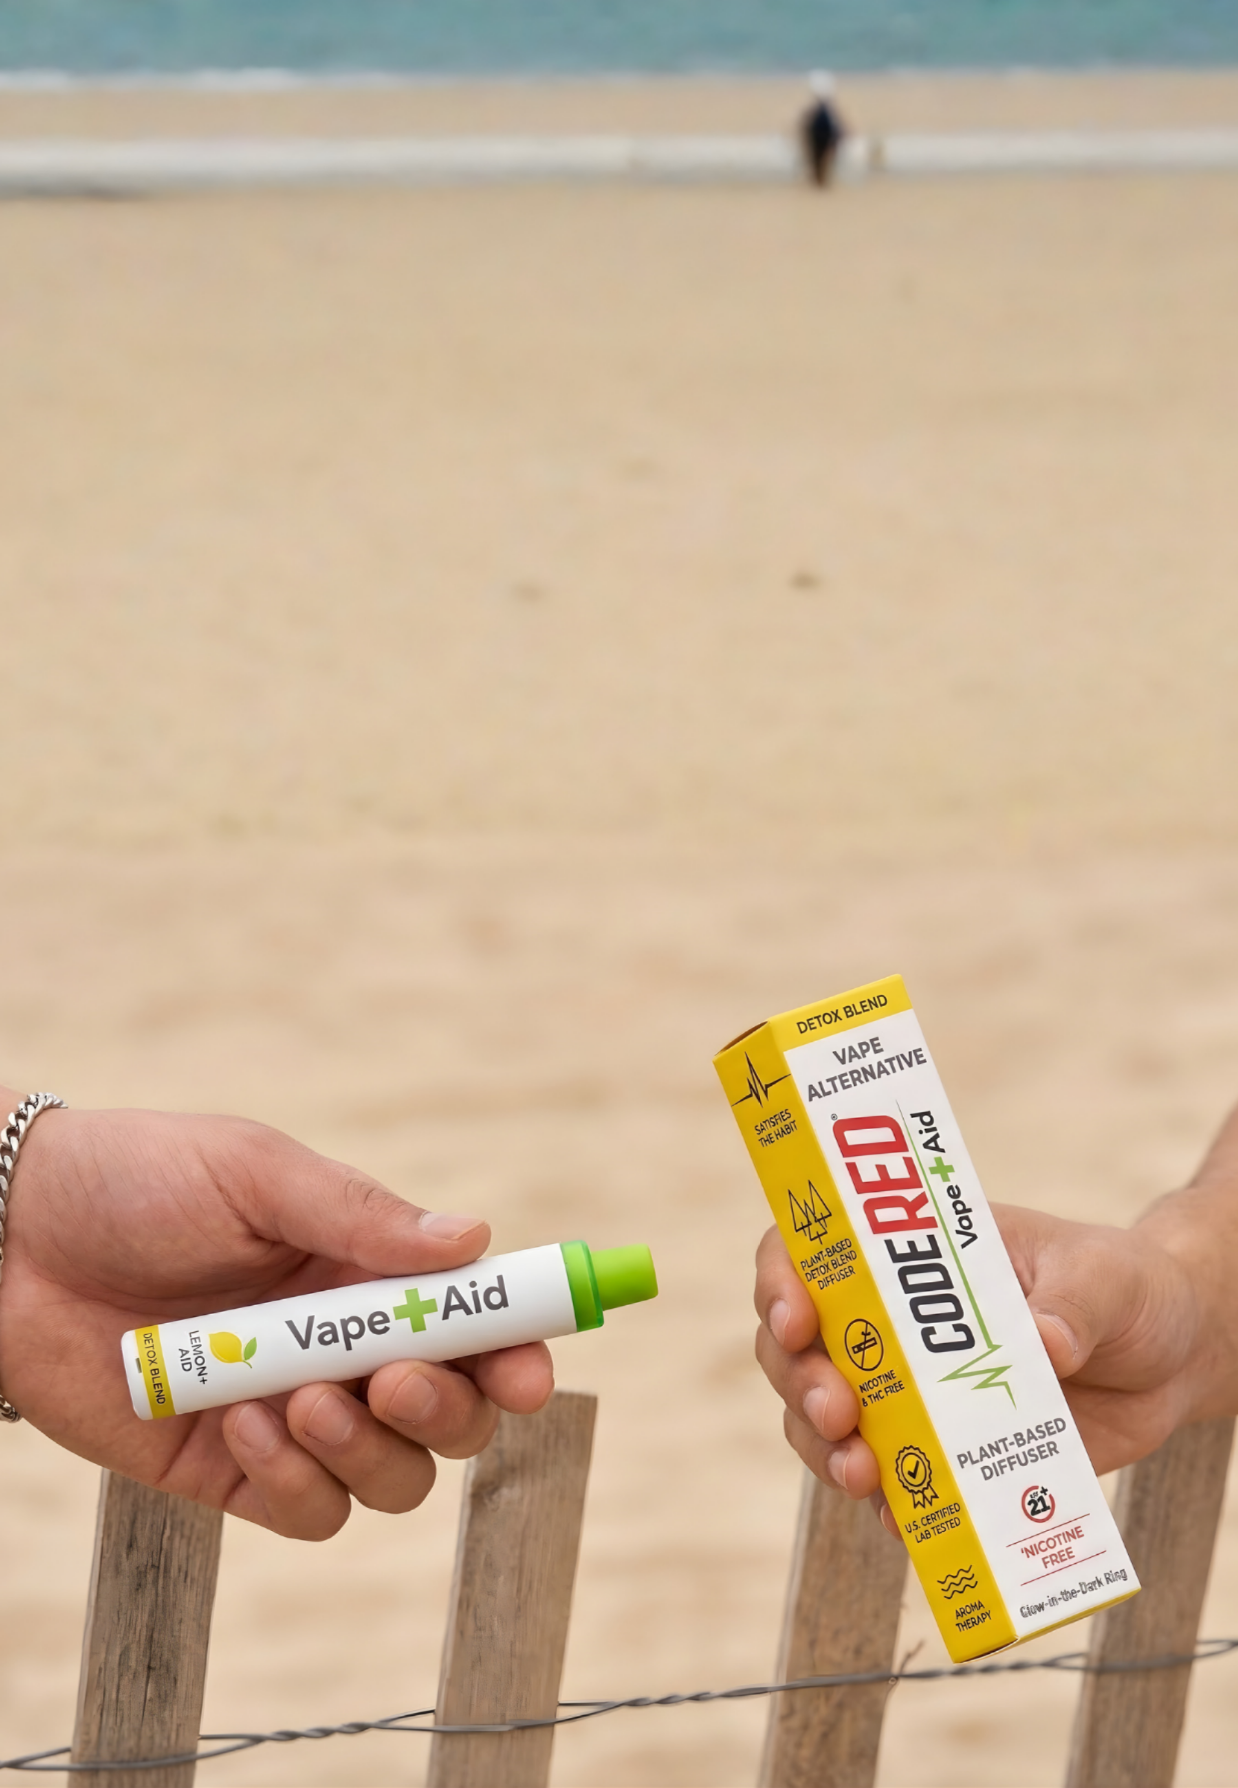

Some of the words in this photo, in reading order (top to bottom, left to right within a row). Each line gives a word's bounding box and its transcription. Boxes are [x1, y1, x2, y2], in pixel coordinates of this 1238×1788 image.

[796, 1008, 842, 1034] DETOX
[843, 994, 888, 1018] BLEND
[832, 1036, 884, 1065] VAPE
[807, 1047, 927, 1102] ALTERNATIVE
[754, 1108, 792, 1135] SATISFIES
[758, 1133, 776, 1148] THE
[774, 1120, 798, 1142] HABIT
[800, 1238, 852, 1271] PLANT-BASED
[805, 1264, 833, 1283] DETOX
[832, 1250, 857, 1270] BLEND
[817, 1265, 856, 1290] DIFFUSER
[143, 1332, 158, 1366] DETOX
[178, 1348, 193, 1372] AID
[150, 1368, 166, 1405] BLEND
[859, 1369, 897, 1393] NICOTINE
[868, 1390, 886, 1405] THC
[884, 1380, 905, 1398] FREE
[957, 1417, 1067, 1469] PLANT-BASED
[980, 1440, 1060, 1481] DIFFUSER
[905, 1518, 921, 1534] U.S.
[920, 1502, 961, 1528] CERTIFIED
[915, 1530, 932, 1543] LAB
[930, 1517, 961, 1539] TESTED
[1041, 1547, 1075, 1569] FREE
[1104, 1568, 1128, 1585] Ring
[955, 1600, 985, 1620] AROMA
[955, 1610, 992, 1633] THERAPY
